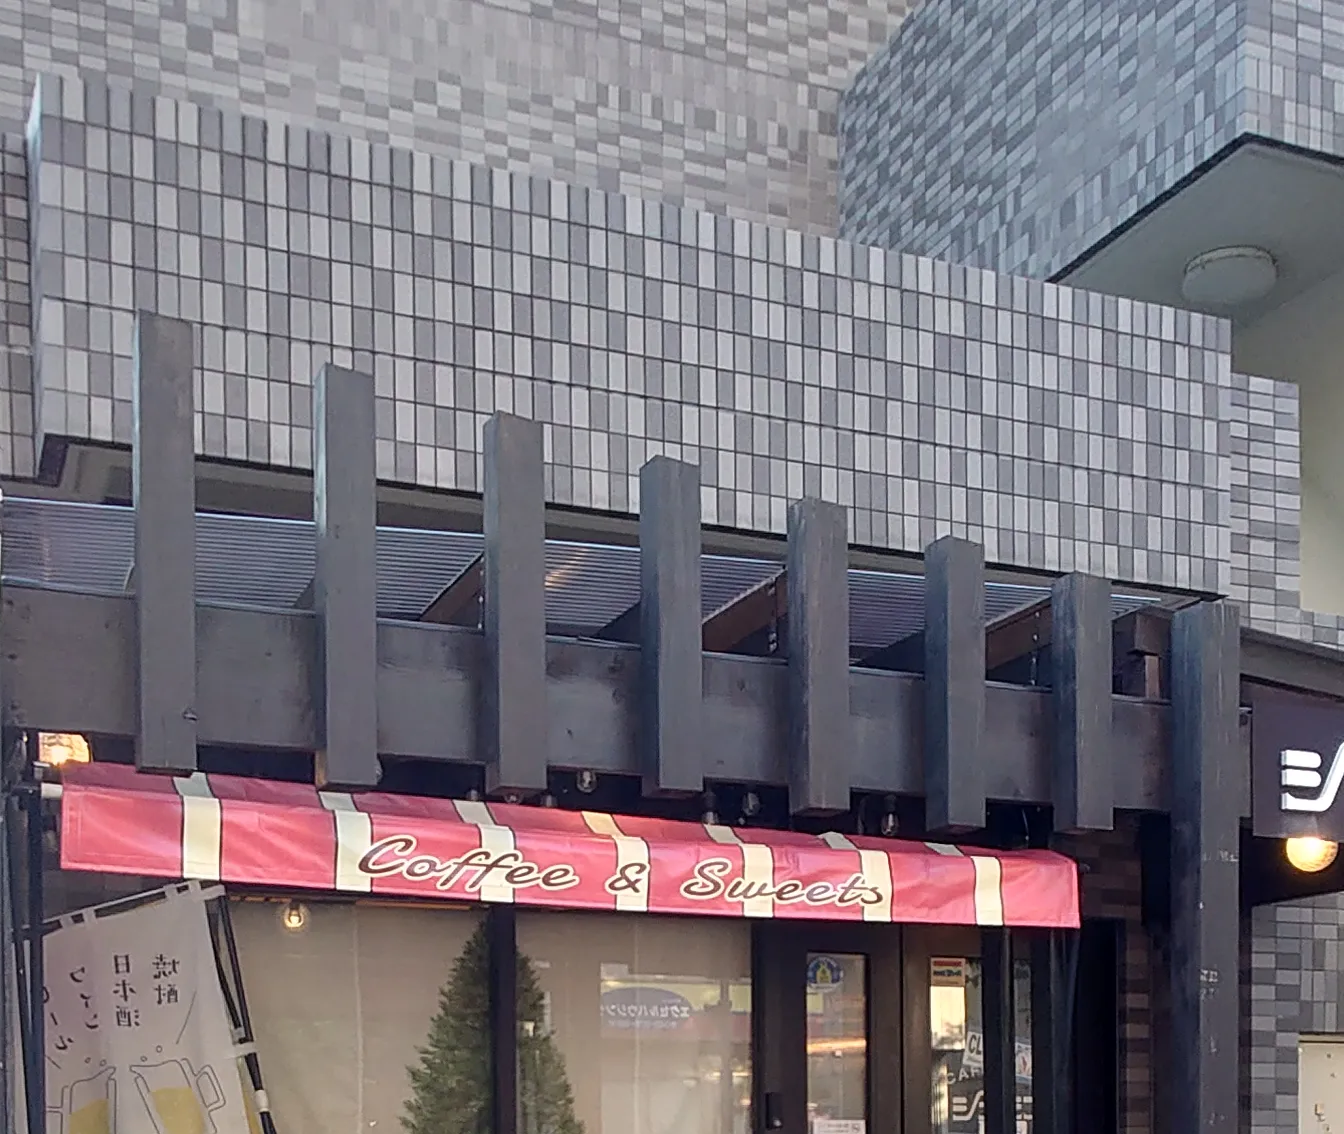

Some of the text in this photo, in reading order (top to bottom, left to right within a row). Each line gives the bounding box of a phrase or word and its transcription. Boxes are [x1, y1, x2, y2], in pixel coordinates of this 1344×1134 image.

[358, 833, 885, 909] Coffee & Sweets
[946, 1066, 983, 1084] CAF
